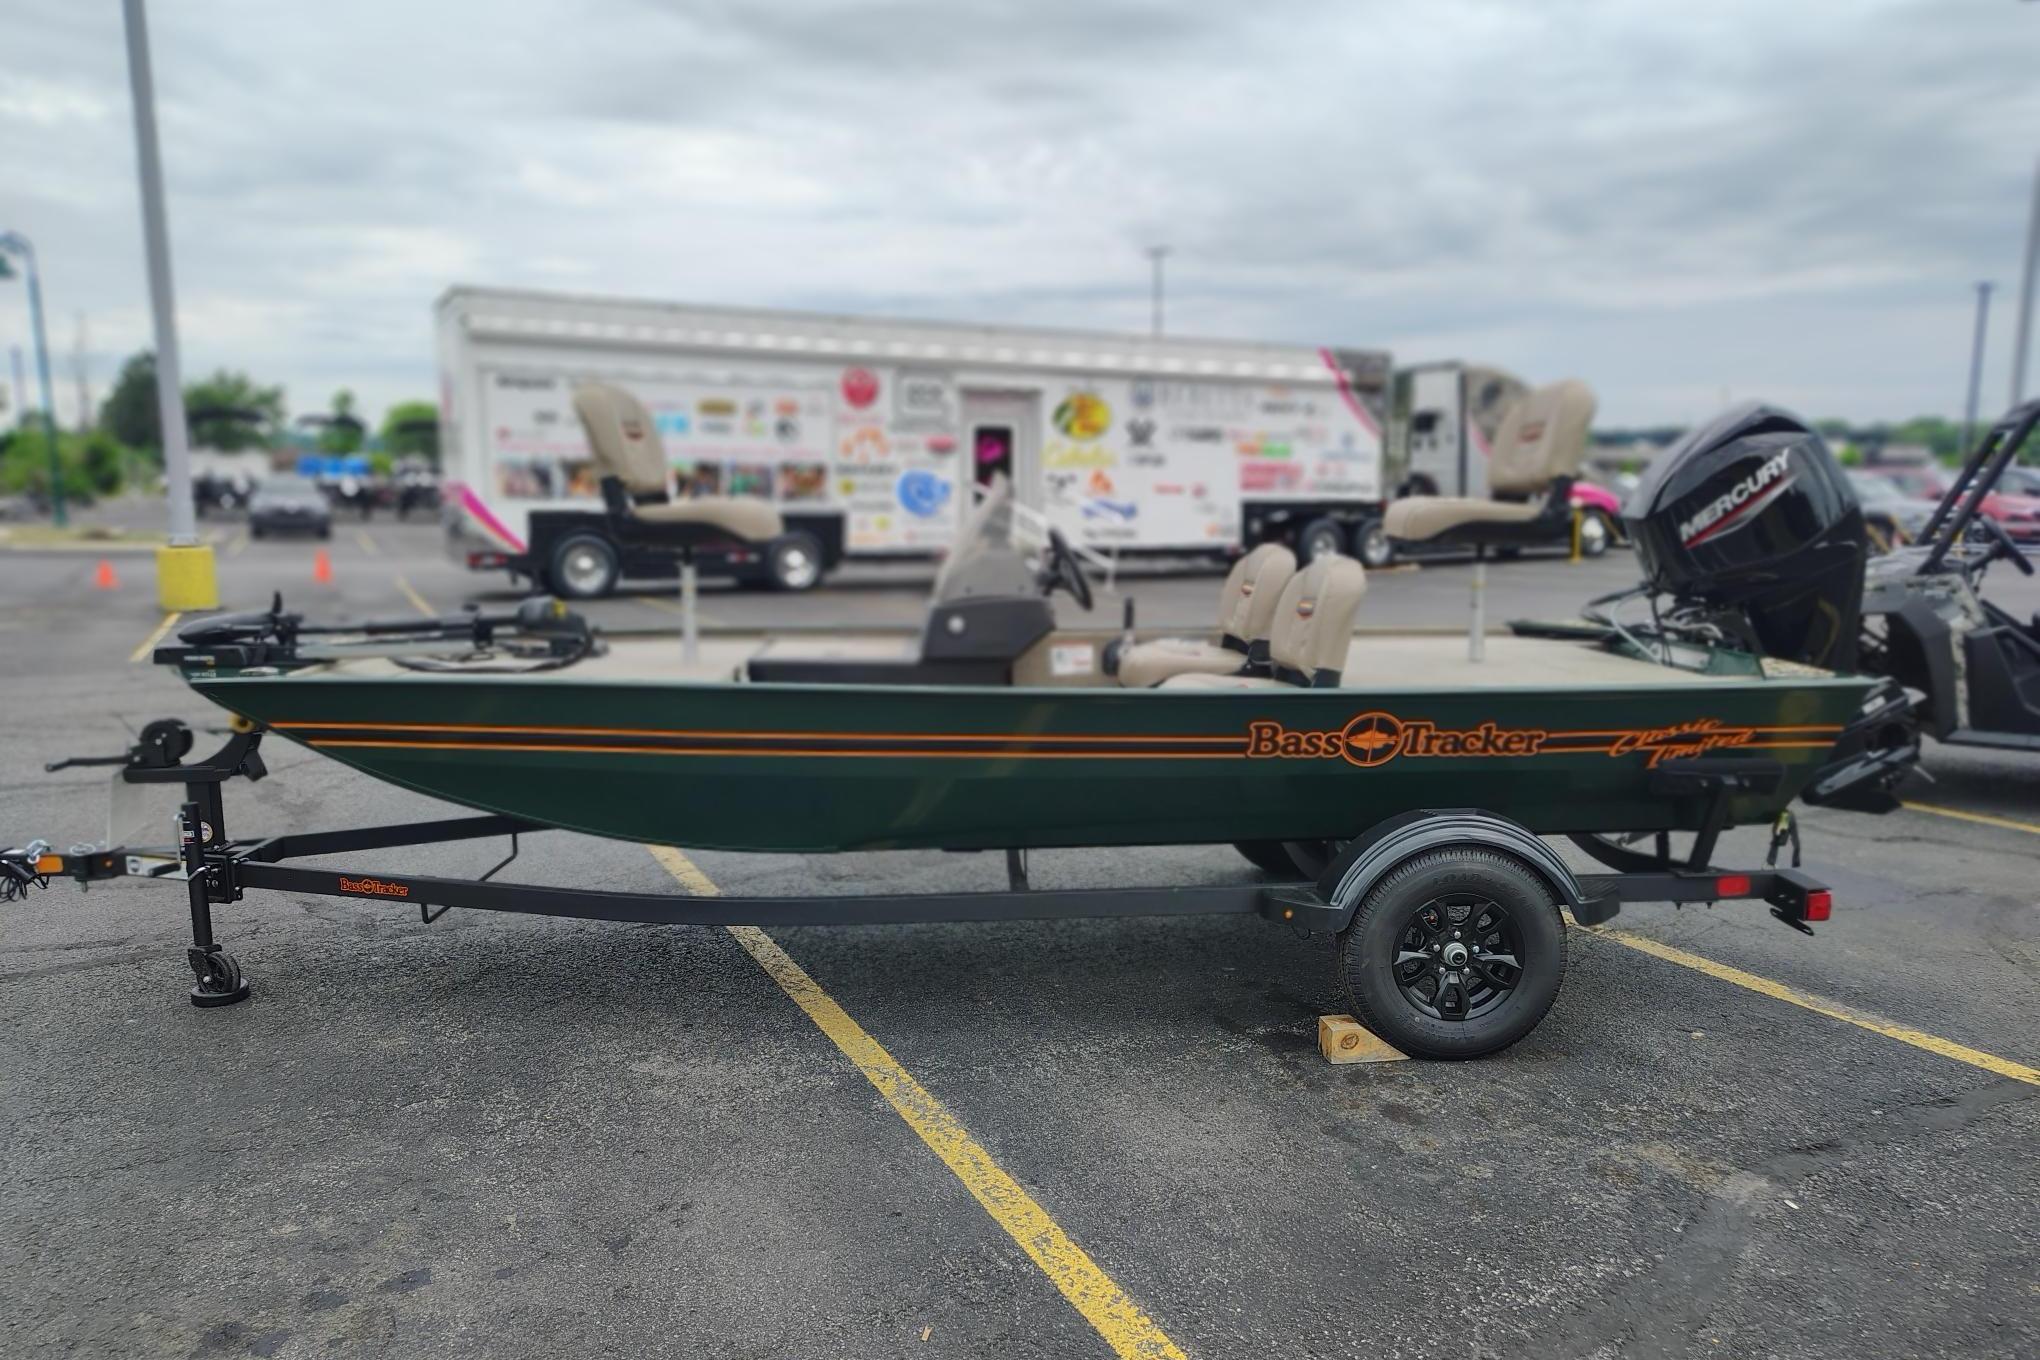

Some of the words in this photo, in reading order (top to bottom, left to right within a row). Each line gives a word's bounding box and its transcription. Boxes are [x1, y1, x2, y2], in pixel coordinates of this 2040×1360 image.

[1680, 447, 1789, 540] MERCURY
[1248, 722, 1344, 758] Bass
[1400, 720, 1546, 757] Tracker
[1608, 718, 1724, 758] Classic
[340, 877, 363, 892] Bass
[371, 880, 408, 896] Tracker
